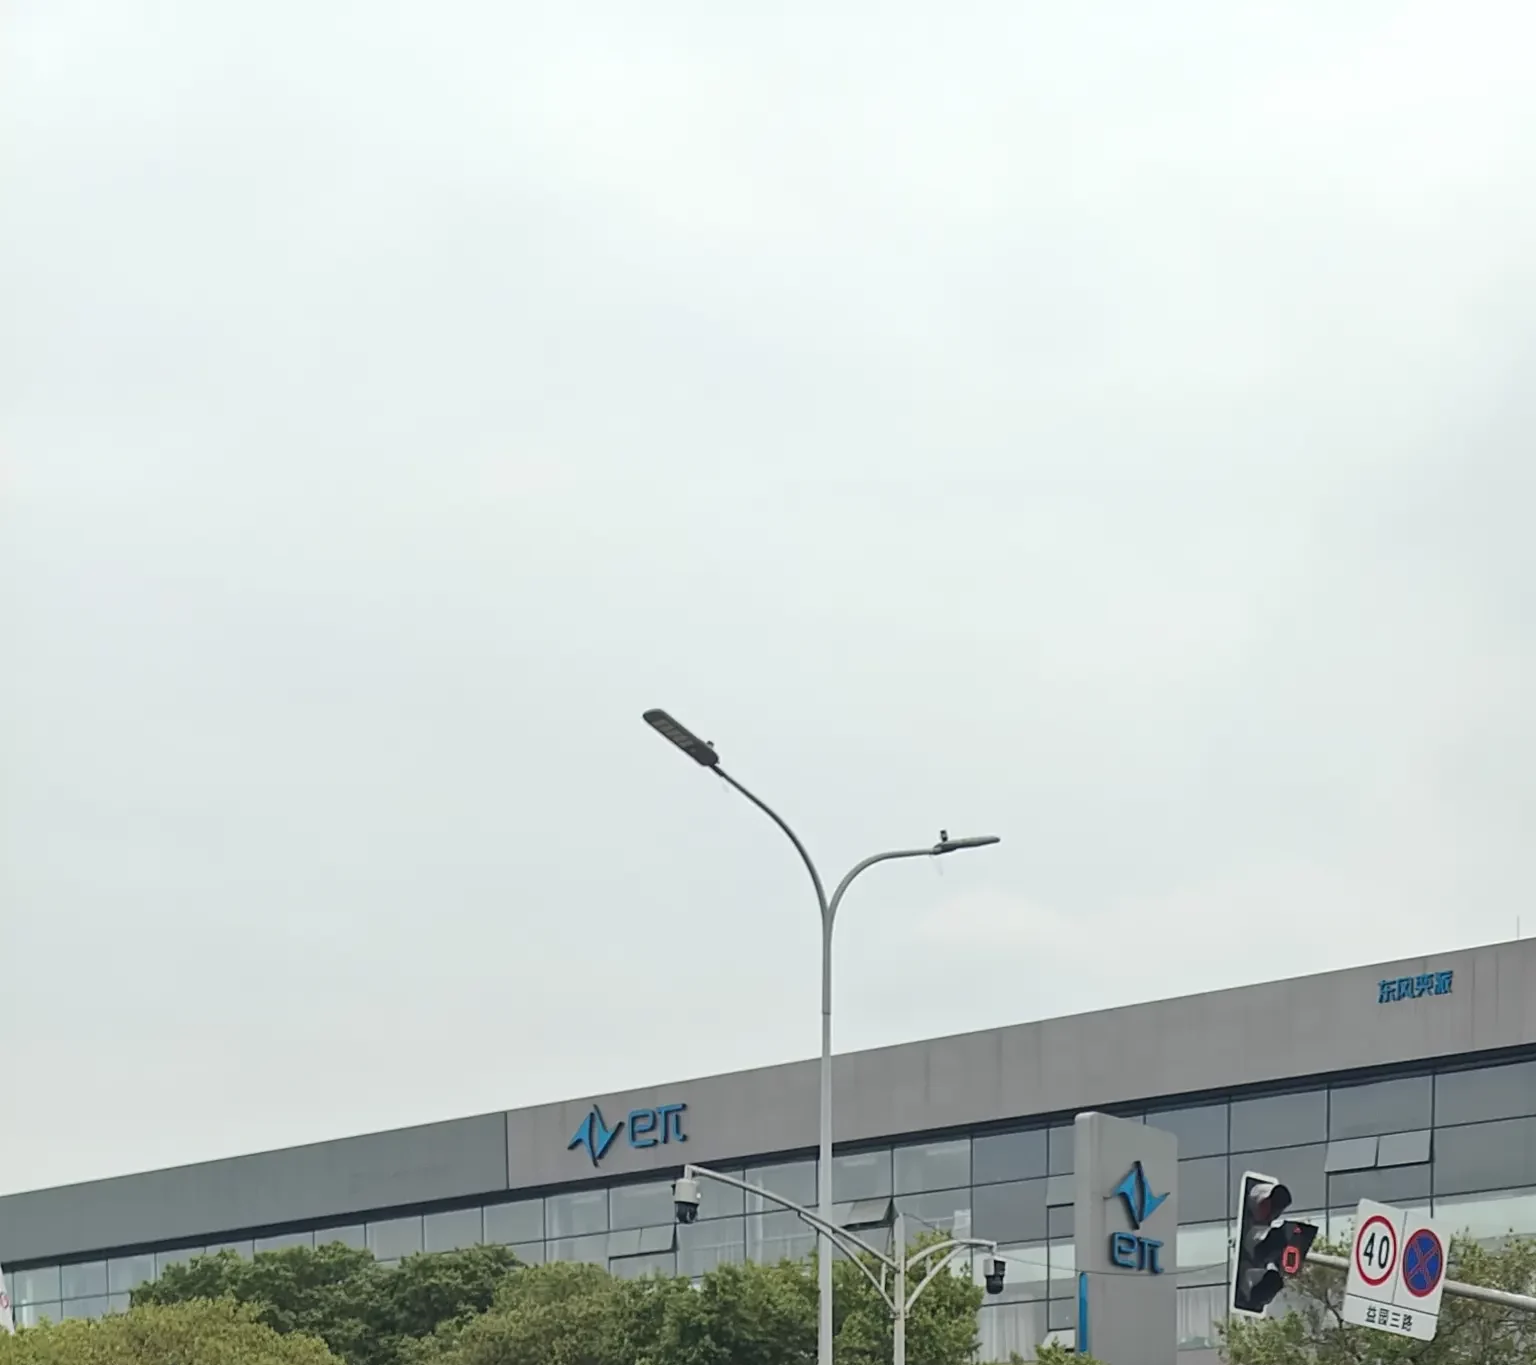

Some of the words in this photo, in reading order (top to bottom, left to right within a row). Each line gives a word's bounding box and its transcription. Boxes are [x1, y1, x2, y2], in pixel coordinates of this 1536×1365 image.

[1377, 970, 1454, 1004] 东风奕派
[1363, 1231, 1390, 1270] 40
